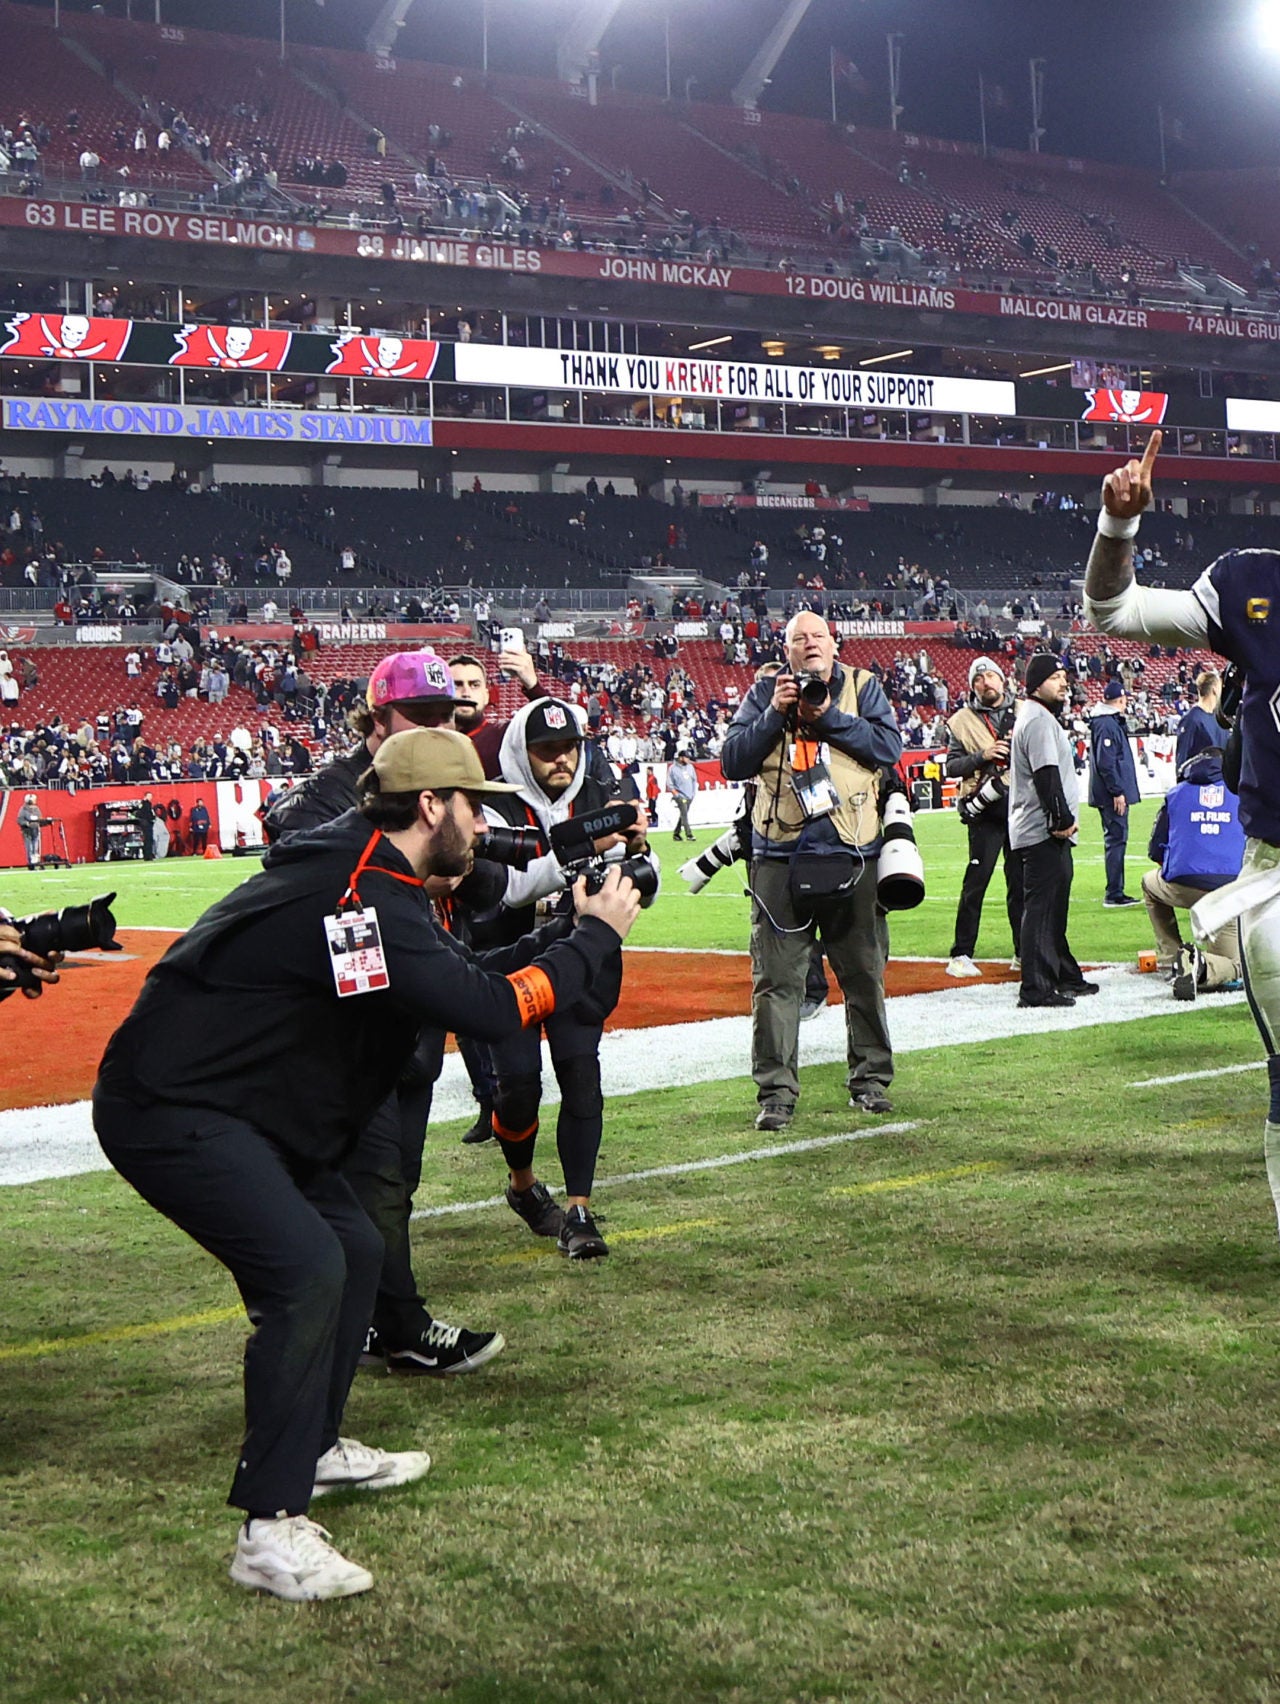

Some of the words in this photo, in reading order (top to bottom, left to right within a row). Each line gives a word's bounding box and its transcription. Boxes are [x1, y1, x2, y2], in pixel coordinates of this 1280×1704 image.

[25, 203, 55, 226] 63
[64, 206, 116, 231] LEE
[124, 211, 180, 237] ROY
[187, 217, 293, 249] SELMON
[390, 237, 469, 266] JIMMIE
[475, 245, 541, 271] GILES
[600, 259, 656, 281] JOHN
[663, 264, 732, 288] MCKAY
[785, 276, 805, 294] 12
[811, 279, 864, 300] DOUG
[870, 284, 955, 309] WILLIAMS
[1000, 297, 1081, 321] MALCOLM
[1086, 307, 1148, 328] GLAZER
[1186, 316, 1203, 332] 74
[1207, 320, 1244, 336] PAUL
[560, 354, 620, 387] THANK
[626, 358, 659, 390] YOU
[665, 361, 723, 394] KREWE
[729, 366, 758, 396] FOR
[765, 368, 793, 398] ALL
[799, 371, 815, 399] OF
[822, 372, 862, 402] YOUR
[867, 375, 934, 406] SUPPORT
[6, 400, 184, 434] RAYMOND
[187, 409, 294, 438] JAMES
[300, 414, 433, 445] STADIUM
[756, 495, 815, 508] BUCCANEERS
[1247, 598, 1270, 618] C
[835, 620, 904, 635] BUCCANEERS
[428, 670, 446, 684] NFL
[549, 714, 565, 724] NFL
[1203, 794, 1221, 803] NFL
[583, 813, 621, 834] RØDE
[1191, 811, 1206, 822] NFL
